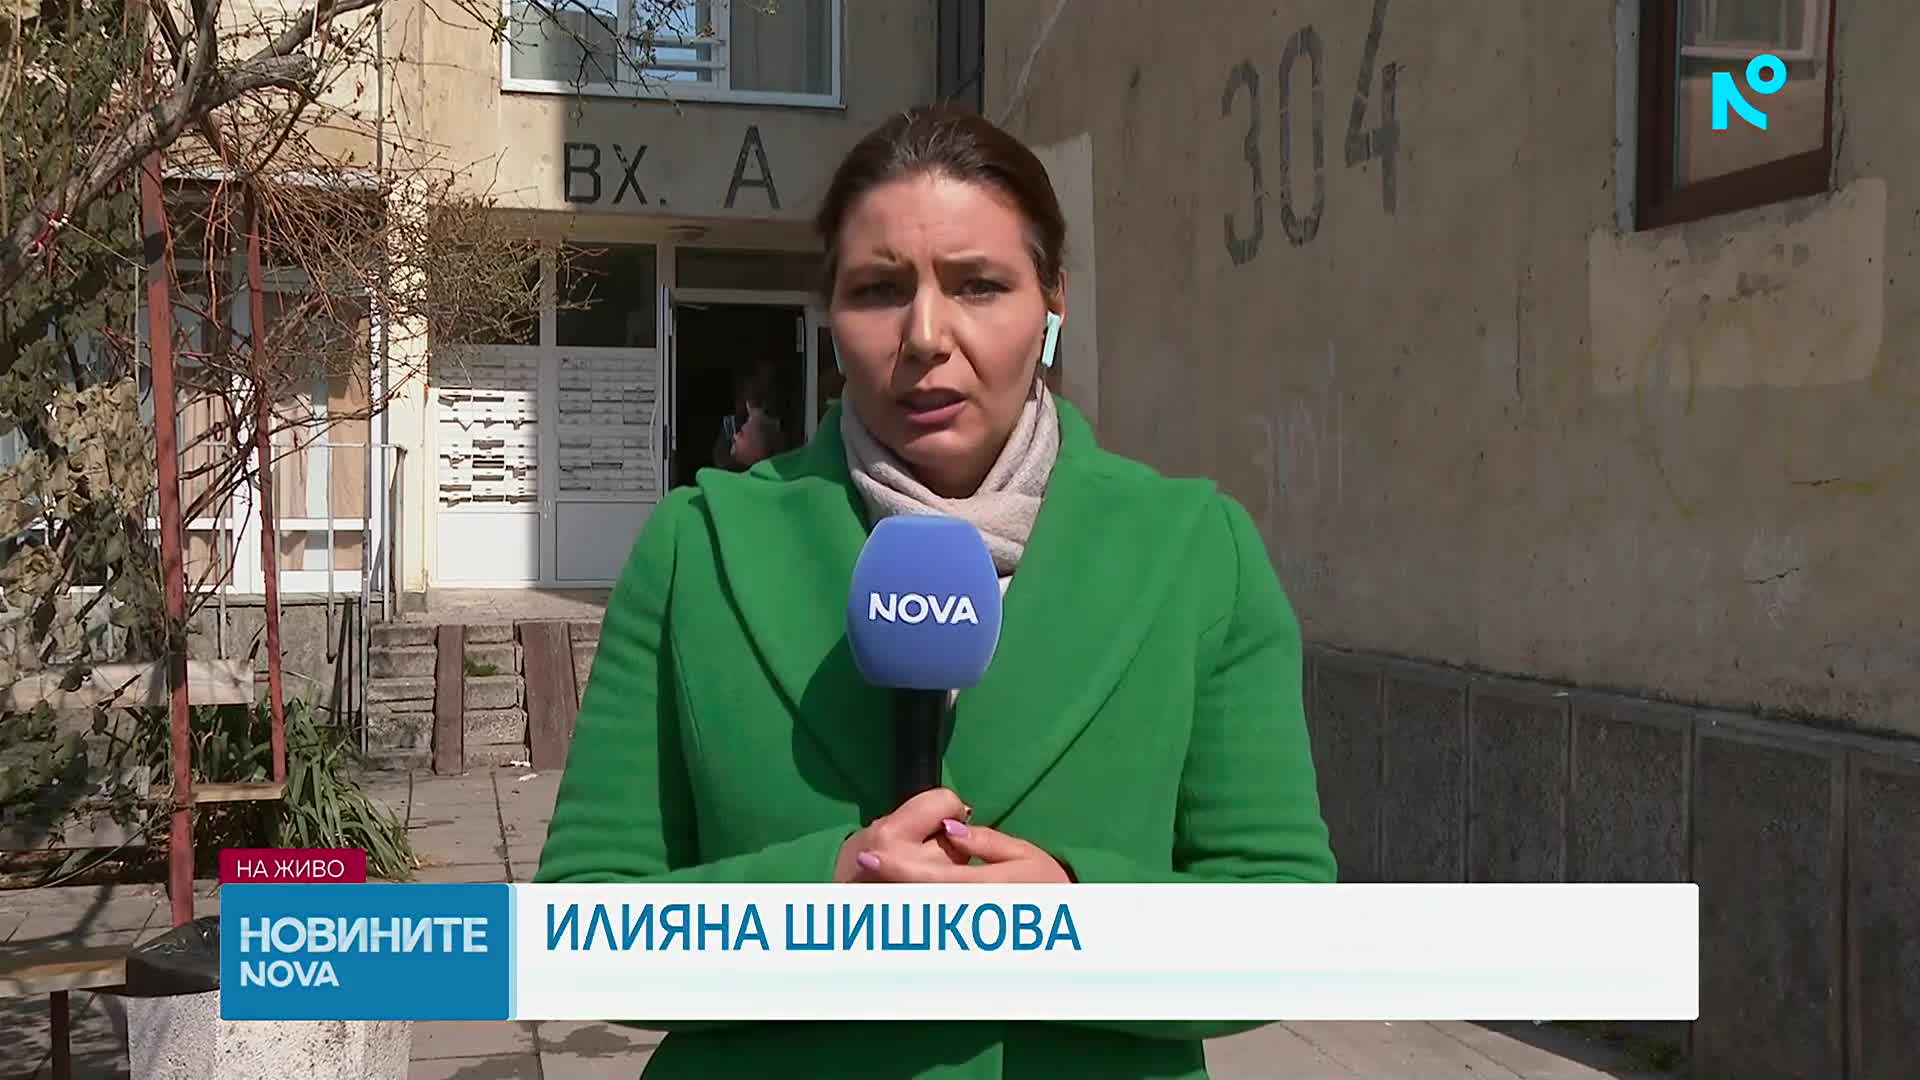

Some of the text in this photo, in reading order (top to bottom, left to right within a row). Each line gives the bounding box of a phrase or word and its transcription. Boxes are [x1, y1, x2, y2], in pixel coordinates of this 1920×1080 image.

[563, 125, 782, 211] ВХ. А
[1221, 0, 1402, 266] 304
[868, 592, 980, 625] NOVA
